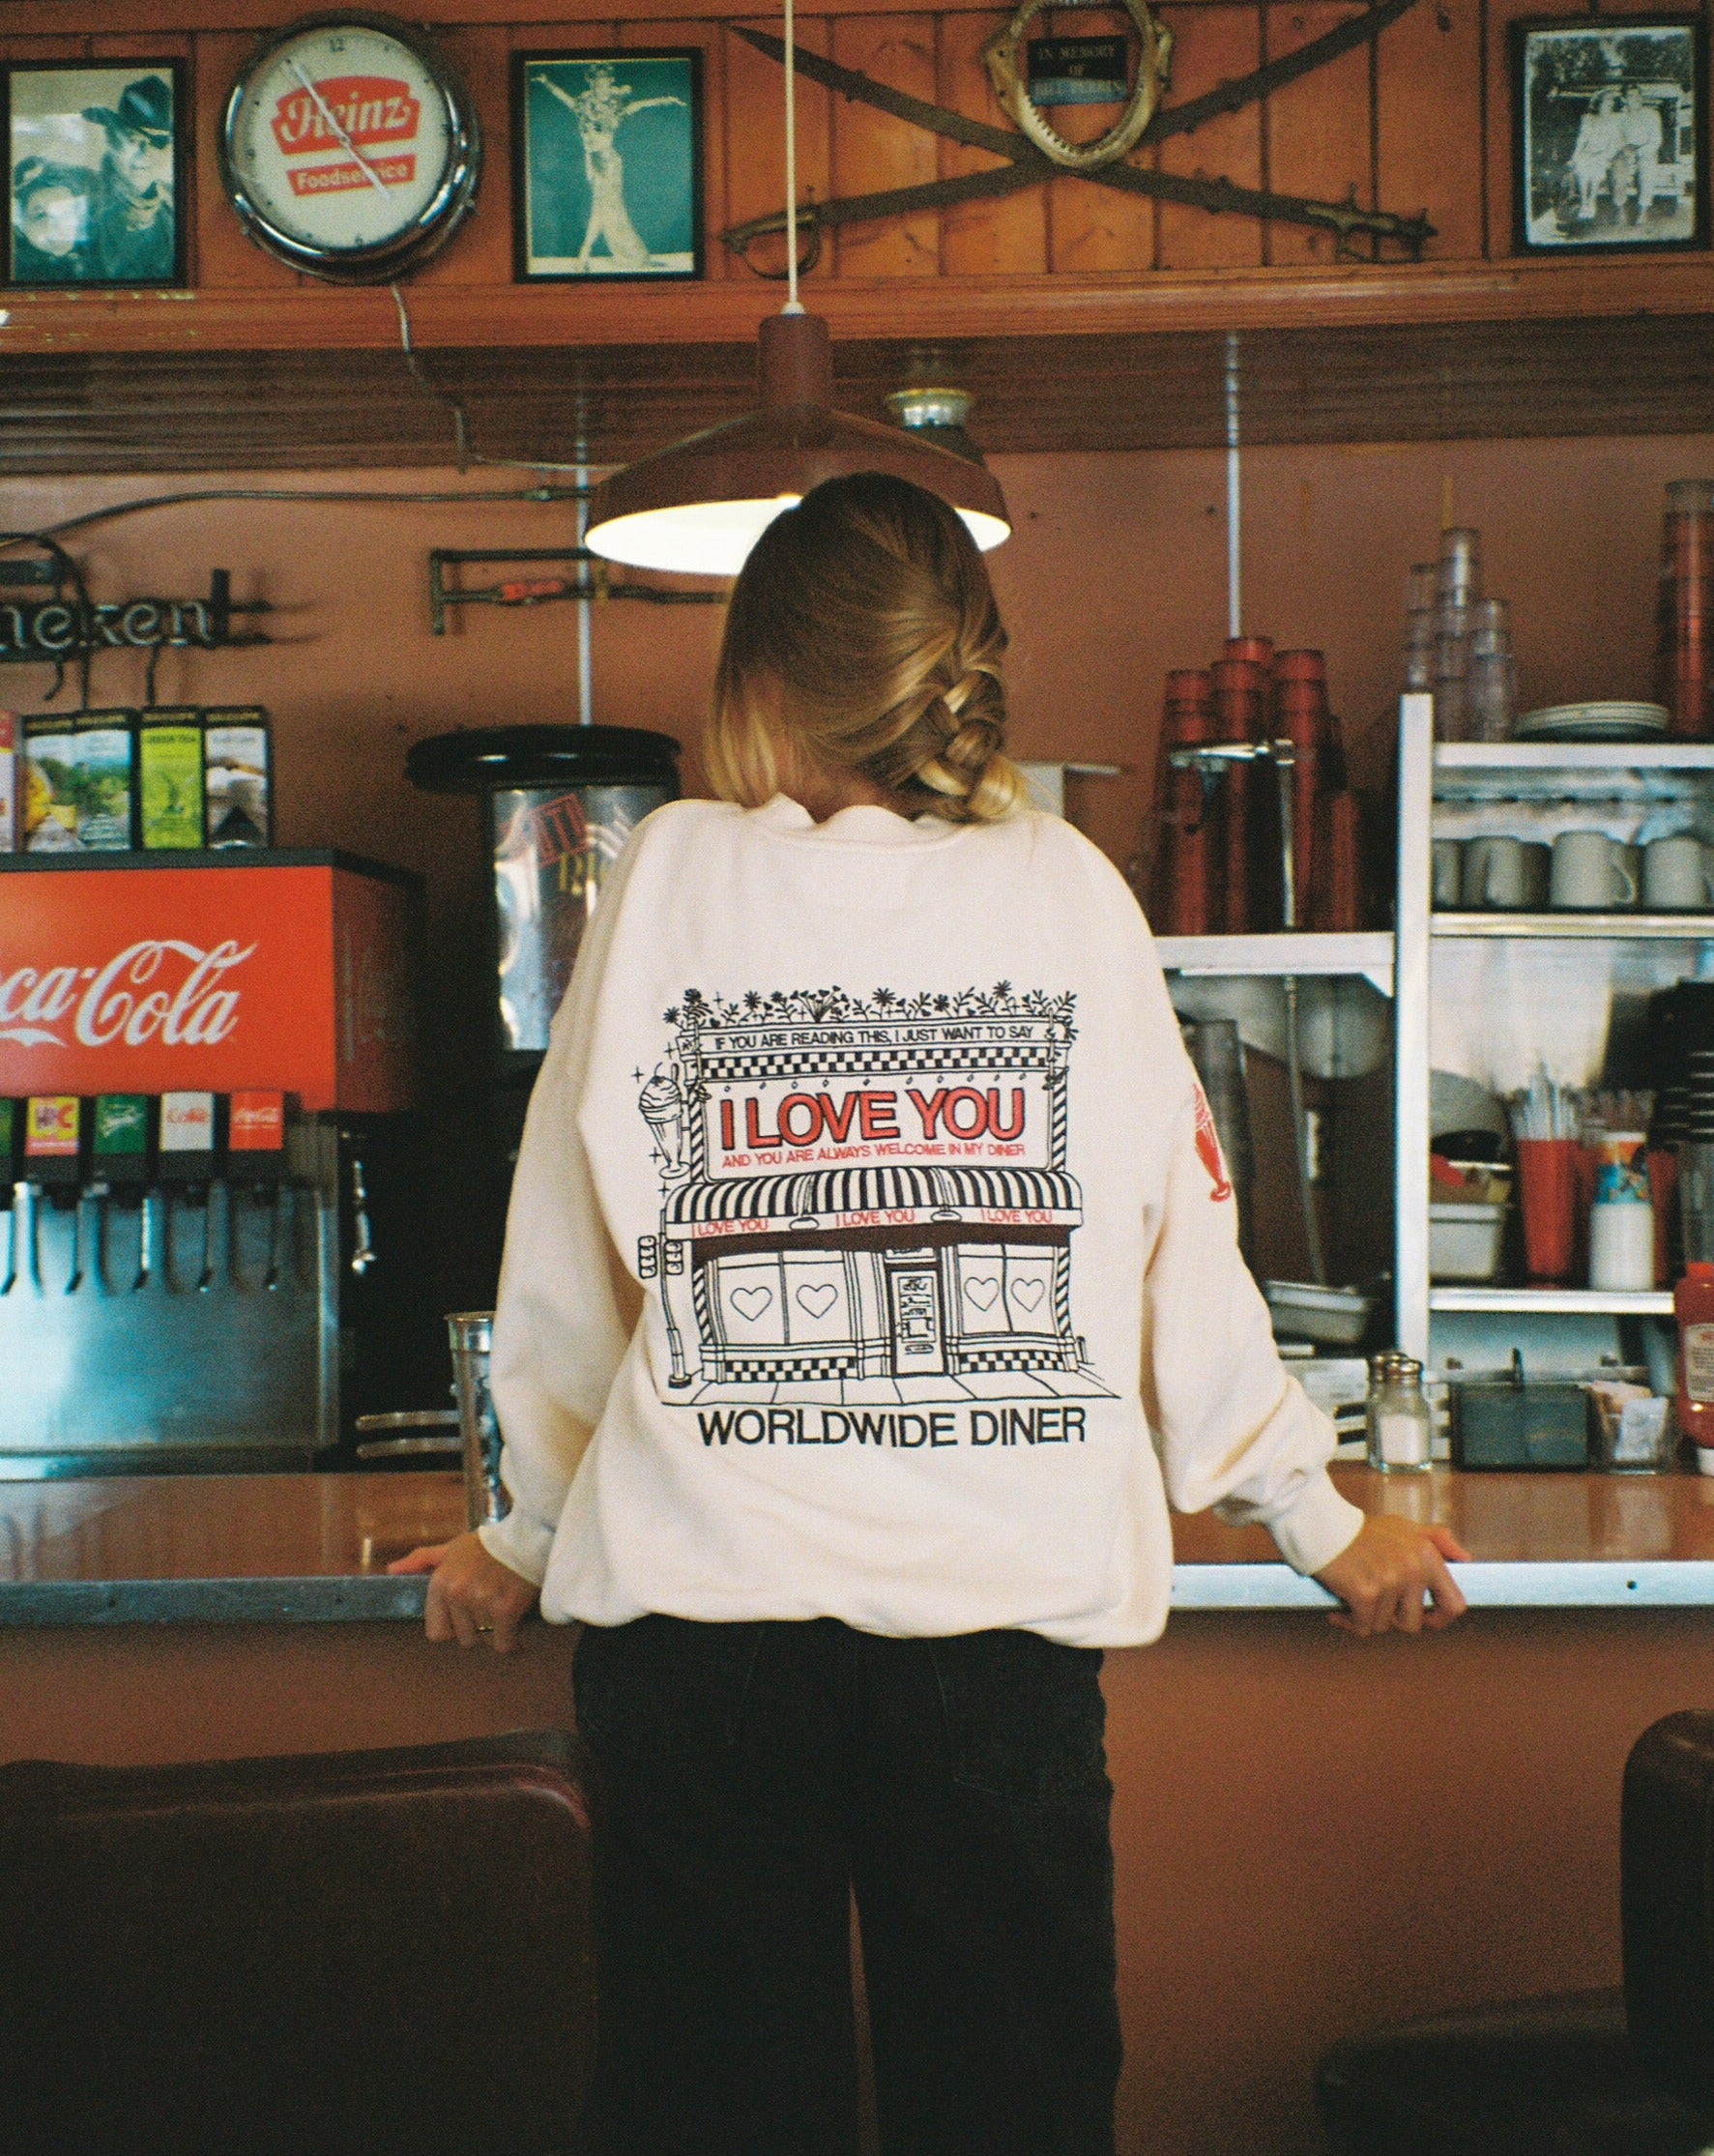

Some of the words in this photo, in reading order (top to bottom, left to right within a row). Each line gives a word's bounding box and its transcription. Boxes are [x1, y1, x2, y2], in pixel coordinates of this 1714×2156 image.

[280, 91, 412, 143] Heinz
[0, 940, 260, 1047] ca-Cola
[714, 1036, 725, 1050] IF
[729, 1034, 757, 1049] YOU
[761, 1033, 788, 1047] ARE
[791, 1031, 854, 1045] READING
[902, 1028, 937, 1042] JUST
[942, 1026, 983, 1040] WANT
[986, 1025, 1005, 1039] TO
[1009, 1025, 1033, 1038] SAY
[720, 1098, 735, 1151] I
[744, 1091, 901, 1150] LOVE
[905, 1086, 1026, 1142] YOU
[721, 1153, 751, 1169] AND
[754, 1151, 782, 1166] YOU
[786, 1149, 814, 1163] ARE
[817, 1145, 871, 1161] ALWAYS
[875, 1142, 945, 1156] WELCOME
[948, 1143, 961, 1155] IN
[964, 1142, 984, 1155] MY
[987, 1143, 1026, 1156] DINER
[697, 1219, 735, 1237] LOVE
[739, 1217, 770, 1233] YOU
[842, 1210, 880, 1227] LOVE
[884, 1209, 915, 1224] YOU
[987, 1209, 1022, 1223] LOVE
[1025, 1209, 1053, 1224] YOU
[697, 1409, 958, 1448] WORLDWIDE
[970, 1406, 1087, 1446] DINER
